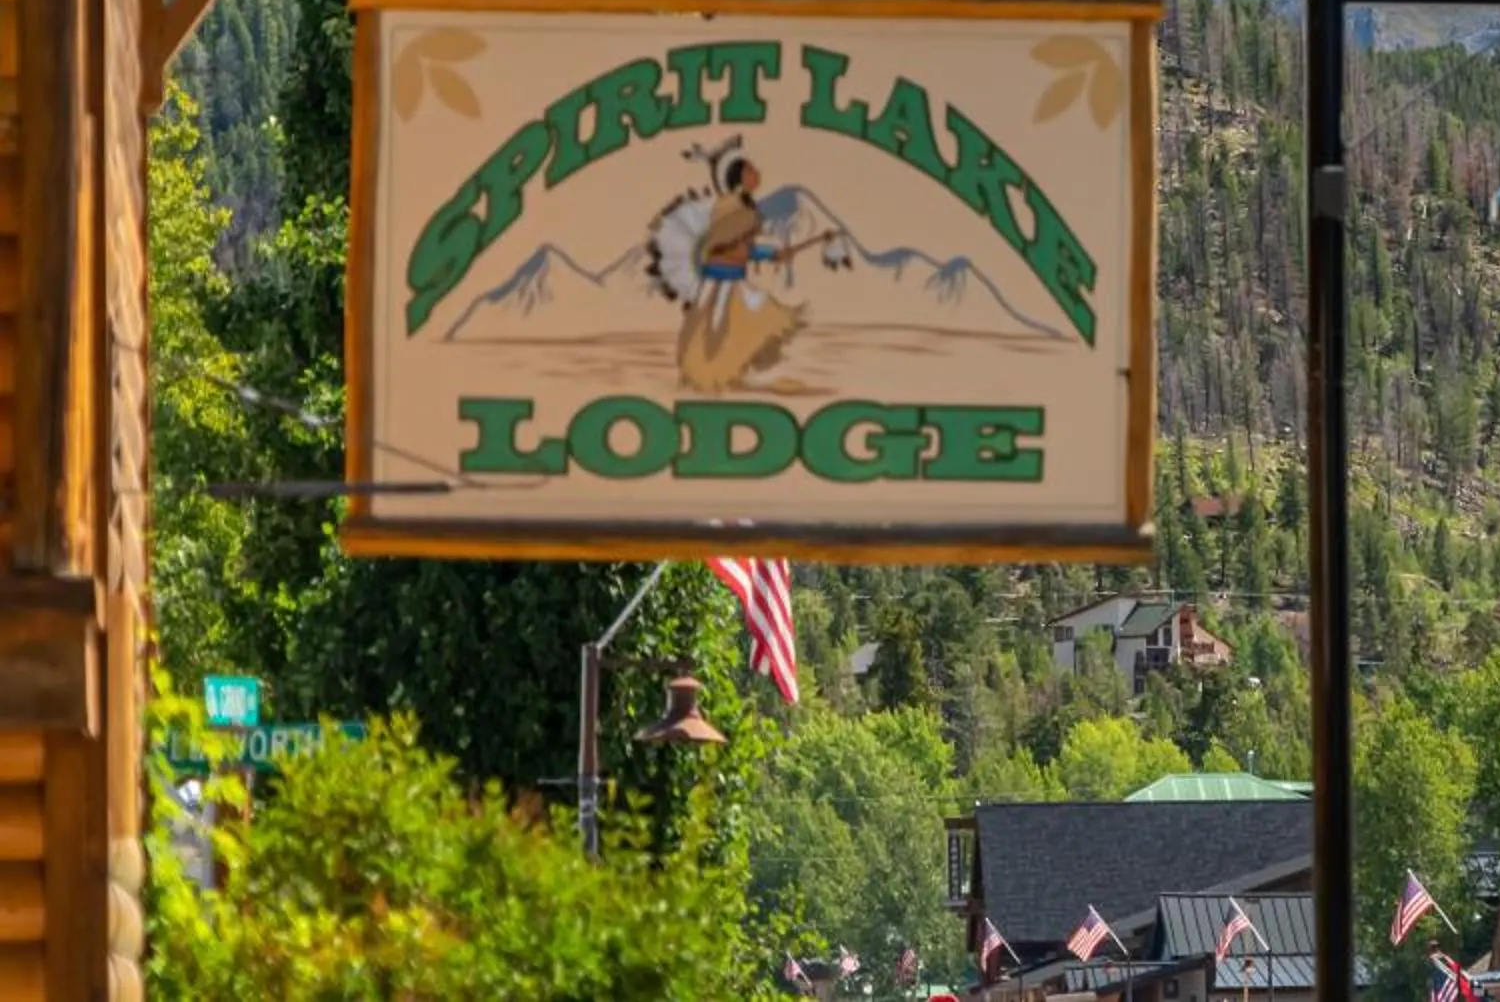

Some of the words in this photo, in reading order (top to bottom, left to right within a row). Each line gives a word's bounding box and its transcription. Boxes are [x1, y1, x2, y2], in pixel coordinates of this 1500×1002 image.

[405, 41, 782, 338] SPIRIT
[800, 45, 1097, 350] LAKE
[458, 397, 1045, 483] LODGE
